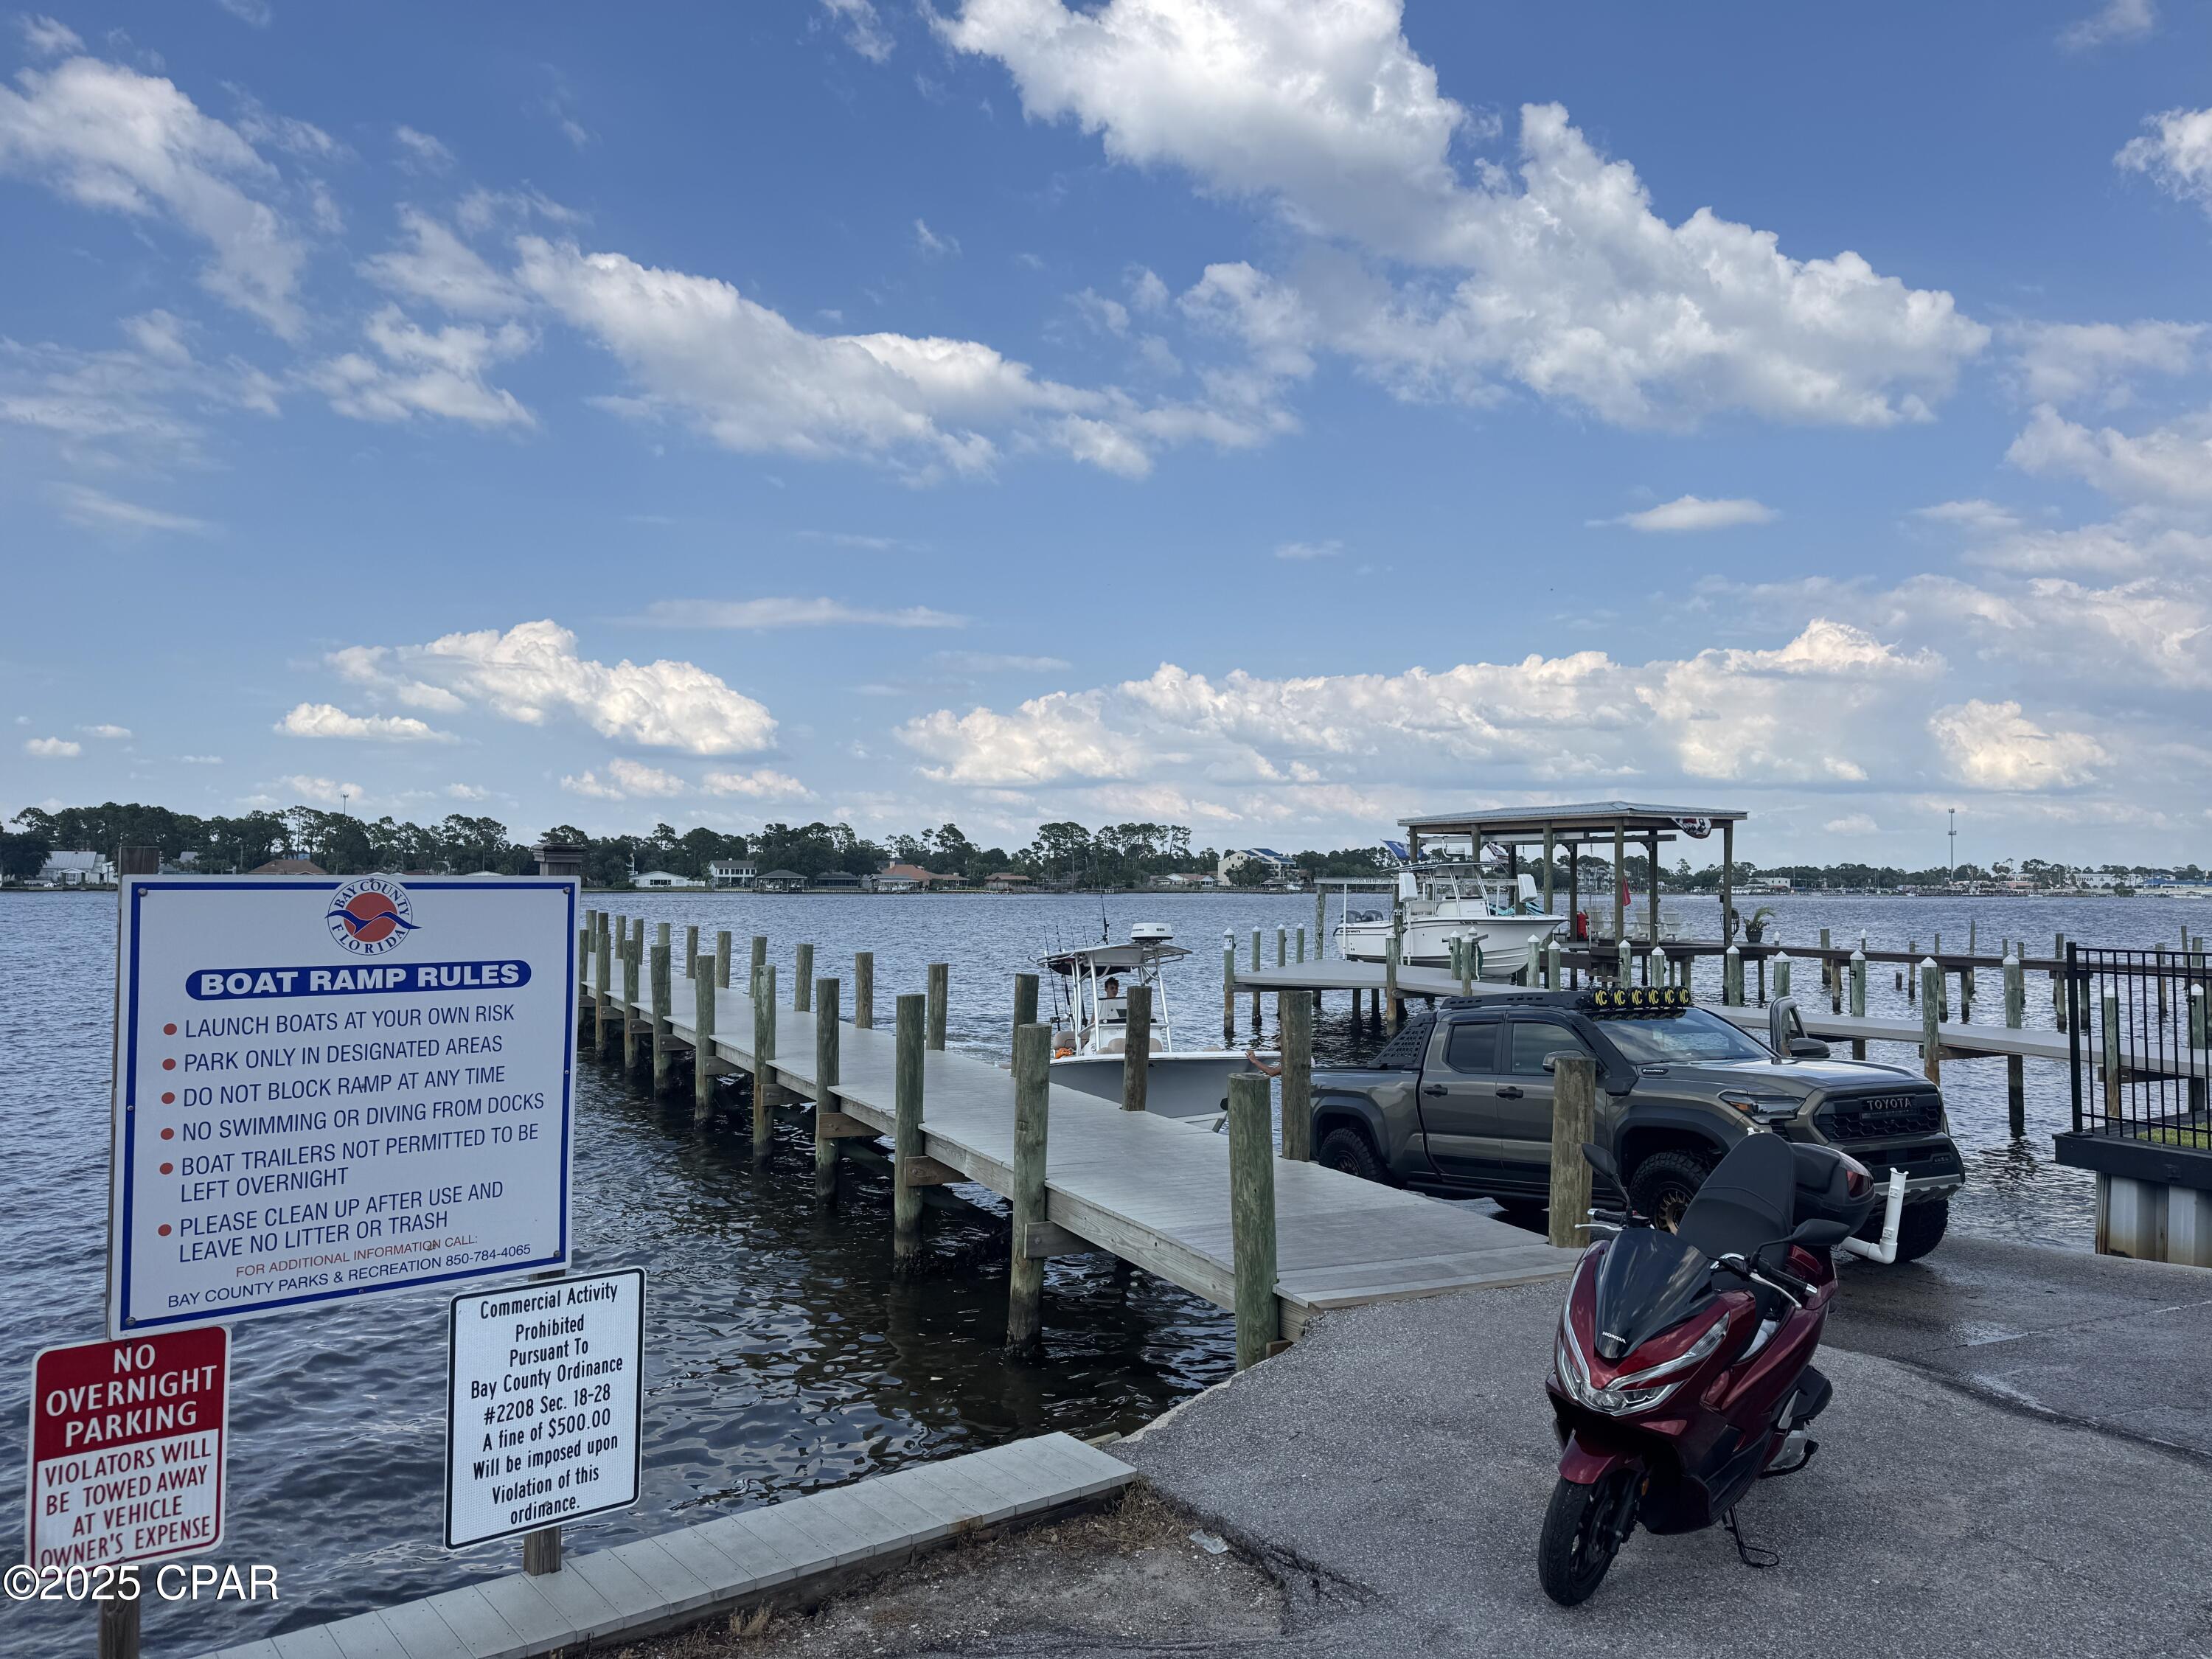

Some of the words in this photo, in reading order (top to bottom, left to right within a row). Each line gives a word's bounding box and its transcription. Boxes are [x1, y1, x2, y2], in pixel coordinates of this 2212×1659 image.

[334, 885, 358, 908] BAY
[360, 881, 410, 916] COUNTY
[332, 923, 406, 953] FLORIDA
[201, 972, 298, 995] BOAT
[310, 969, 406, 991] RAMP
[418, 964, 518, 987] RULES
[1595, 990, 1607, 1006] KC
[1613, 990, 1626, 1006] KC
[1632, 989, 1643, 1005] KC
[1648, 989, 1659, 1004] KC
[1664, 989, 1674, 1004] KC
[1679, 988, 1688, 1004] KC
[187, 1016, 268, 1037] LAUNCH
[277, 1013, 337, 1032] BOATS
[344, 1012, 366, 1029] AT
[372, 1009, 420, 1027] YOUR
[428, 1006, 469, 1024] OWN
[476, 1004, 514, 1022] RISK
[185, 1051, 238, 1072] PARK
[246, 1048, 296, 1068] ONLY
[302, 1047, 319, 1064] IN
[327, 1040, 439, 1062] DESIGNATED
[446, 1036, 501, 1055] AREAS
[184, 1088, 212, 1106] DO
[221, 1084, 261, 1104] NOT
[269, 1079, 330, 1100] BLOCK
[338, 1075, 392, 1094] RAMP
[397, 1073, 419, 1090] AT
[425, 1069, 459, 1088] ANY
[465, 1066, 504, 1084] TIME
[1867, 1097, 1912, 1110] TOYOTA
[184, 1121, 211, 1141] NO
[220, 1112, 326, 1138] SWIMMING
[334, 1110, 358, 1127] OR
[367, 1104, 425, 1124] DIVING
[434, 1099, 481, 1119] FROM
[488, 1093, 543, 1113] DOCKS
[182, 1154, 234, 1175] BOAT
[242, 1144, 335, 1169] TRAILERS
[343, 1140, 380, 1159] NOT
[387, 1130, 484, 1155] PERMITTED
[491, 1127, 512, 1144] TO
[519, 1124, 538, 1141] BE
[181, 1180, 229, 1202] LEFT
[237, 1167, 348, 1196] OVERNIGHT
[181, 1211, 257, 1237] PLEASE
[265, 1203, 327, 1226] CLEAN
[335, 1199, 359, 1217] UP
[366, 1192, 421, 1214] AFTER
[430, 1186, 462, 1206] USE
[468, 1182, 502, 1200] AND
[180, 1237, 242, 1262] LEAVE
[251, 1233, 277, 1253] NO
[286, 1224, 348, 1248] LITTER
[357, 1220, 381, 1238] OR
[389, 1211, 447, 1234] TRASH
[237, 1264, 265, 1277] FOR
[269, 1253, 349, 1273] ADDITIONAL
[355, 1239, 440, 1260] INFORMATION
[445, 1235, 477, 1247] CALL:
[169, 1292, 200, 1307] BAY
[206, 1281, 274, 1301] COUNTY
[279, 1273, 328, 1291] PARKS
[334, 1272, 344, 1283] &
[349, 1257, 441, 1281] RECREATION
[446, 1245, 530, 1266] 850-784-4065
[481, 1290, 562, 1320] Commercial
[567, 1282, 617, 1305] Activity
[516, 1314, 584, 1342] Prohibited
[1601, 1331, 1627, 1344] HONDA
[114, 1344, 155, 1373] NO
[510, 1340, 568, 1367] Pursuant
[574, 1338, 588, 1354] To
[46, 1366, 217, 1416] OVERNIGHT
[472, 1381, 497, 1399] Bay
[504, 1368, 551, 1392] County
[557, 1358, 622, 1382] Ordinance
[66, 1401, 196, 1447] PARKING
[484, 1399, 533, 1425] #2208
[540, 1396, 566, 1413] Sec.
[574, 1383, 610, 1407] 18-28
[483, 1433, 492, 1452] A
[499, 1430, 524, 1448] fine
[531, 1422, 543, 1441] of
[549, 1407, 610, 1439] $500.00
[46, 1447, 154, 1487] VIOLATORS
[161, 1439, 211, 1464] WILL
[473, 1458, 498, 1480] Will
[507, 1455, 521, 1472] be
[528, 1439, 580, 1468] imposed
[588, 1436, 617, 1456] upon
[46, 1492, 69, 1516] BE
[83, 1476, 150, 1507] TOWED
[156, 1465, 207, 1492] AWAY
[493, 1478, 552, 1504] Violation
[559, 1470, 570, 1489] of
[575, 1464, 599, 1484] this
[73, 1513, 95, 1537] AT
[104, 1495, 181, 1529] VEHICLE
[511, 1497, 580, 1524] ordinance.
[41, 1533, 123, 1568] OWNER'S
[136, 1516, 209, 1549] EXPENSE
